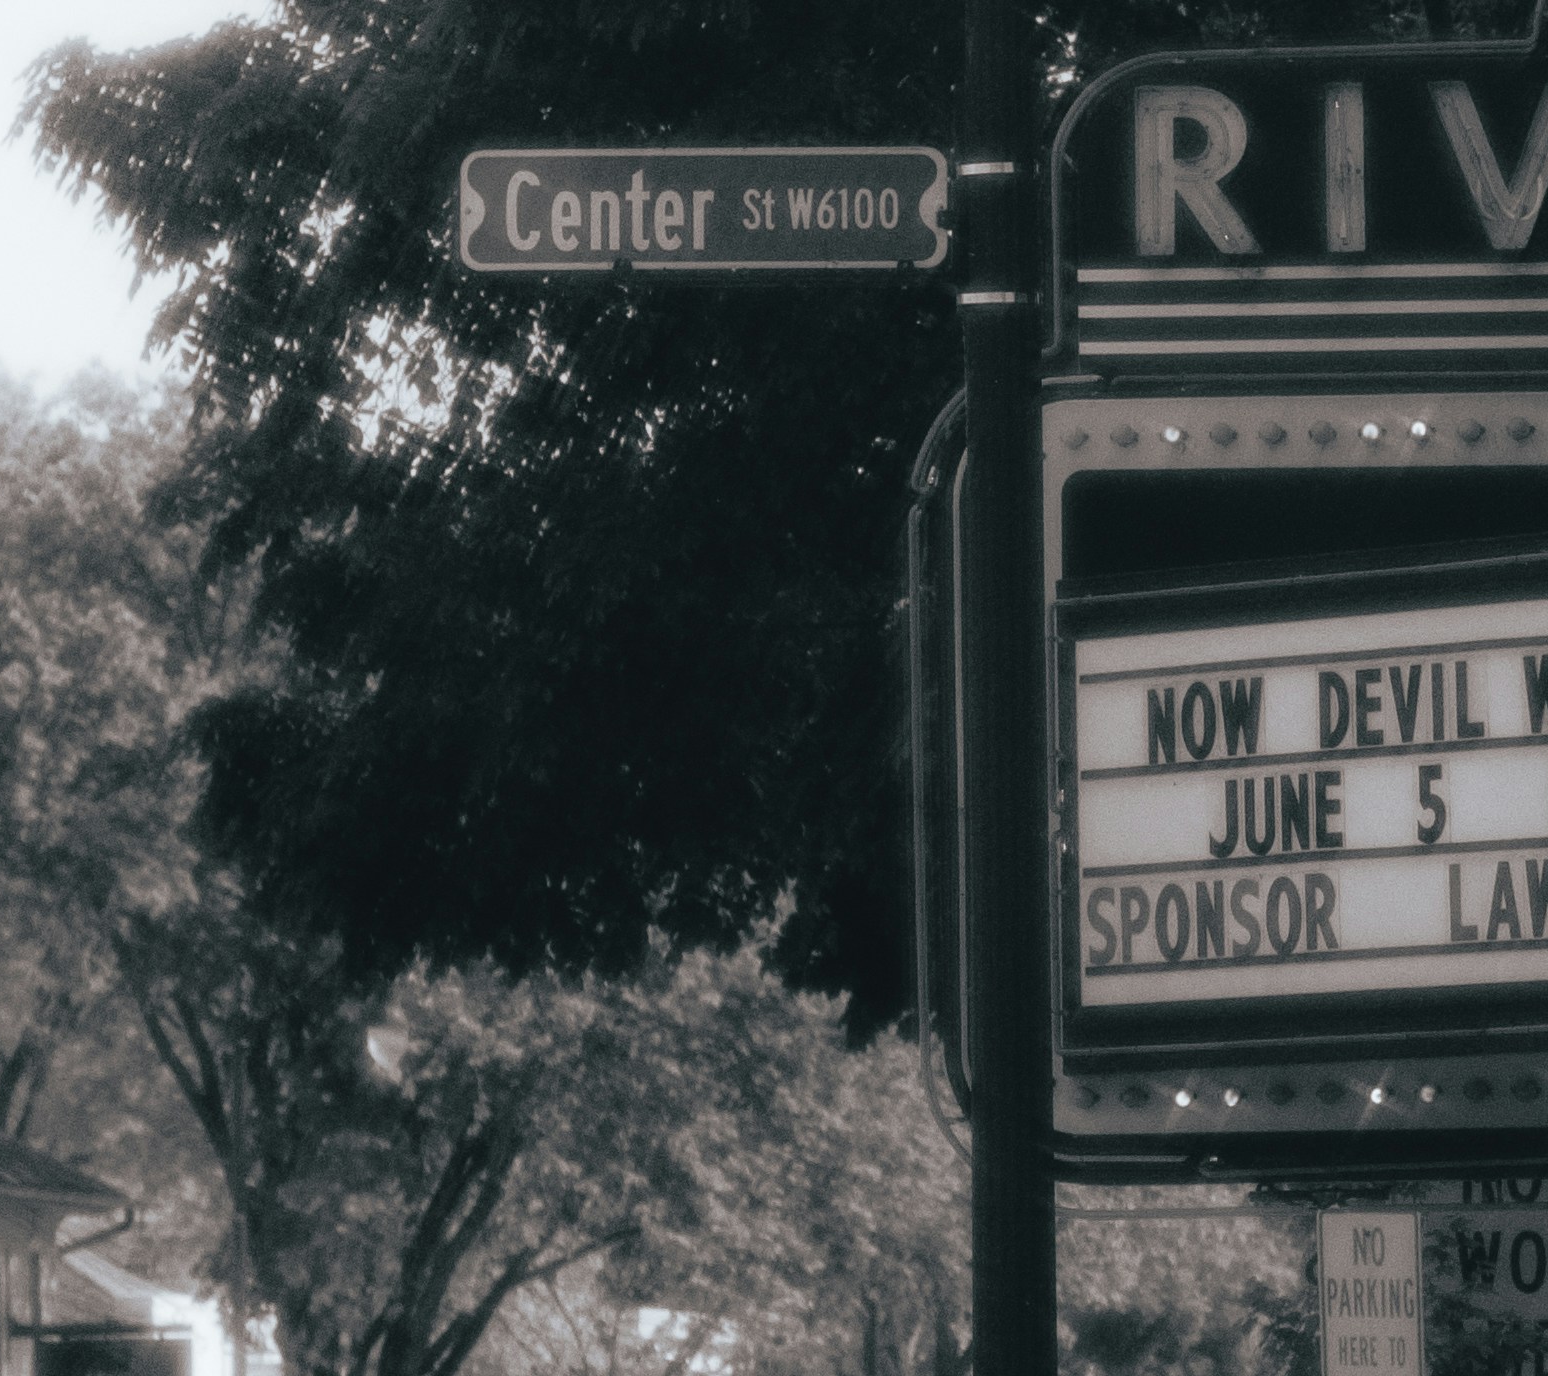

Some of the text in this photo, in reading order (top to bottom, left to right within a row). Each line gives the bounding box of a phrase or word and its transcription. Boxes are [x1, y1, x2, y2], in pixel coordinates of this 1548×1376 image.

[505, 169, 900, 252] Center St W6100
[1146, 676, 1263, 765] NOW
[1318, 659, 1485, 750] DEVIL
[1208, 769, 1344, 860] JUNE
[1415, 764, 1447, 846] 5
[1086, 872, 1338, 968] SPONSOR
[1353, 1227, 1386, 1267] NO
[1327, 1277, 1415, 1319] PARKING
[1338, 1335, 1406, 1368] HERE TO
